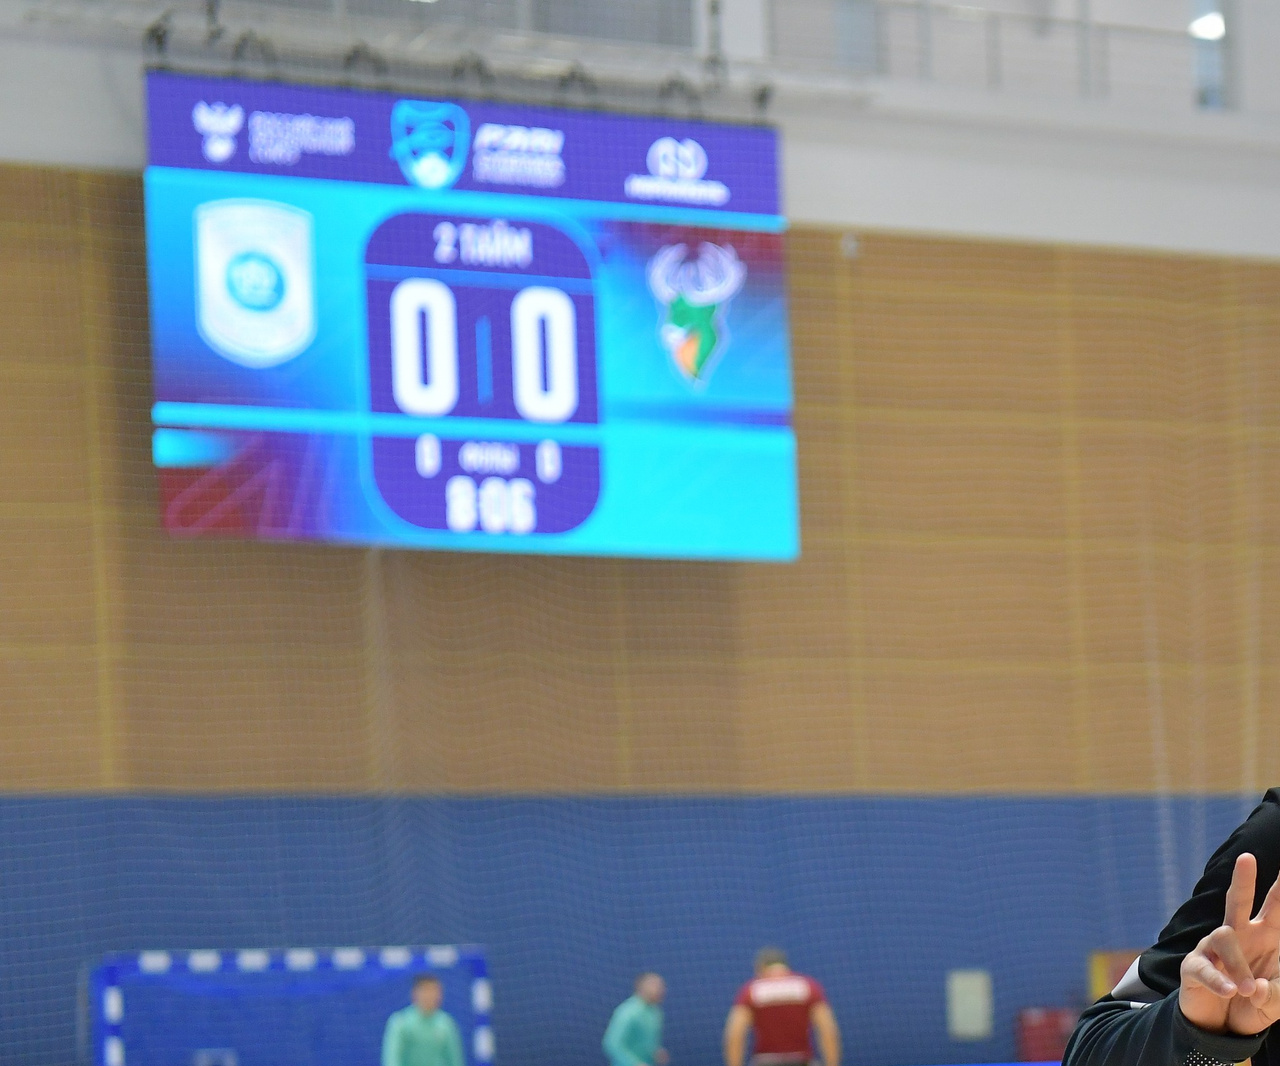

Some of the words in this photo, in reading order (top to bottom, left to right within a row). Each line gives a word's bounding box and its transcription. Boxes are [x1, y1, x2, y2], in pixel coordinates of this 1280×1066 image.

[433, 221, 458, 264] 2
[459, 219, 533, 268] ТАЙМ
[390, 277, 459, 418] 0
[510, 286, 579, 424] 0
